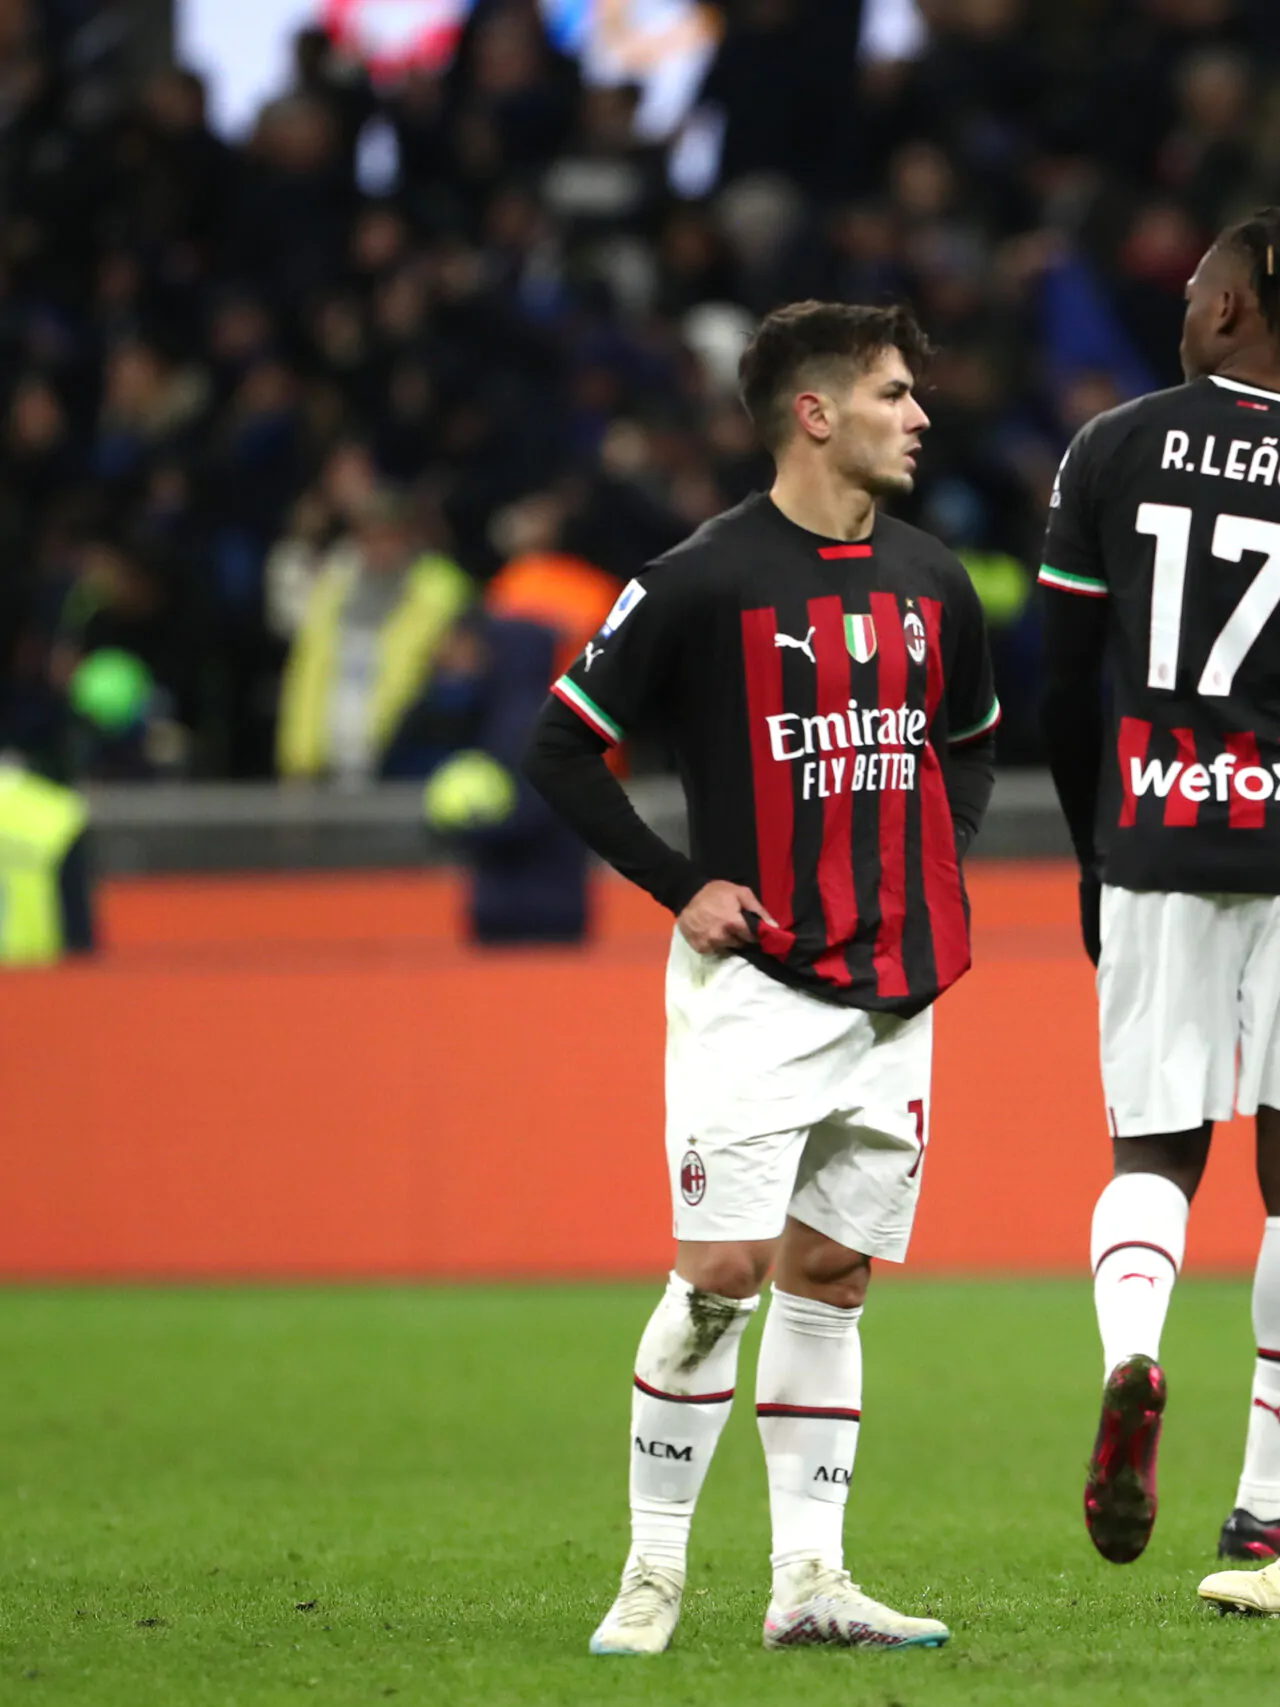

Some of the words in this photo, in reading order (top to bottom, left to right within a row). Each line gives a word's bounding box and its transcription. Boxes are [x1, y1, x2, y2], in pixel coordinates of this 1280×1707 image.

[765, 698, 930, 762] Emirate
[802, 756, 846, 800] FLY
[851, 752, 916, 792] BETTER
[635, 1436, 693, 1462] ACM
